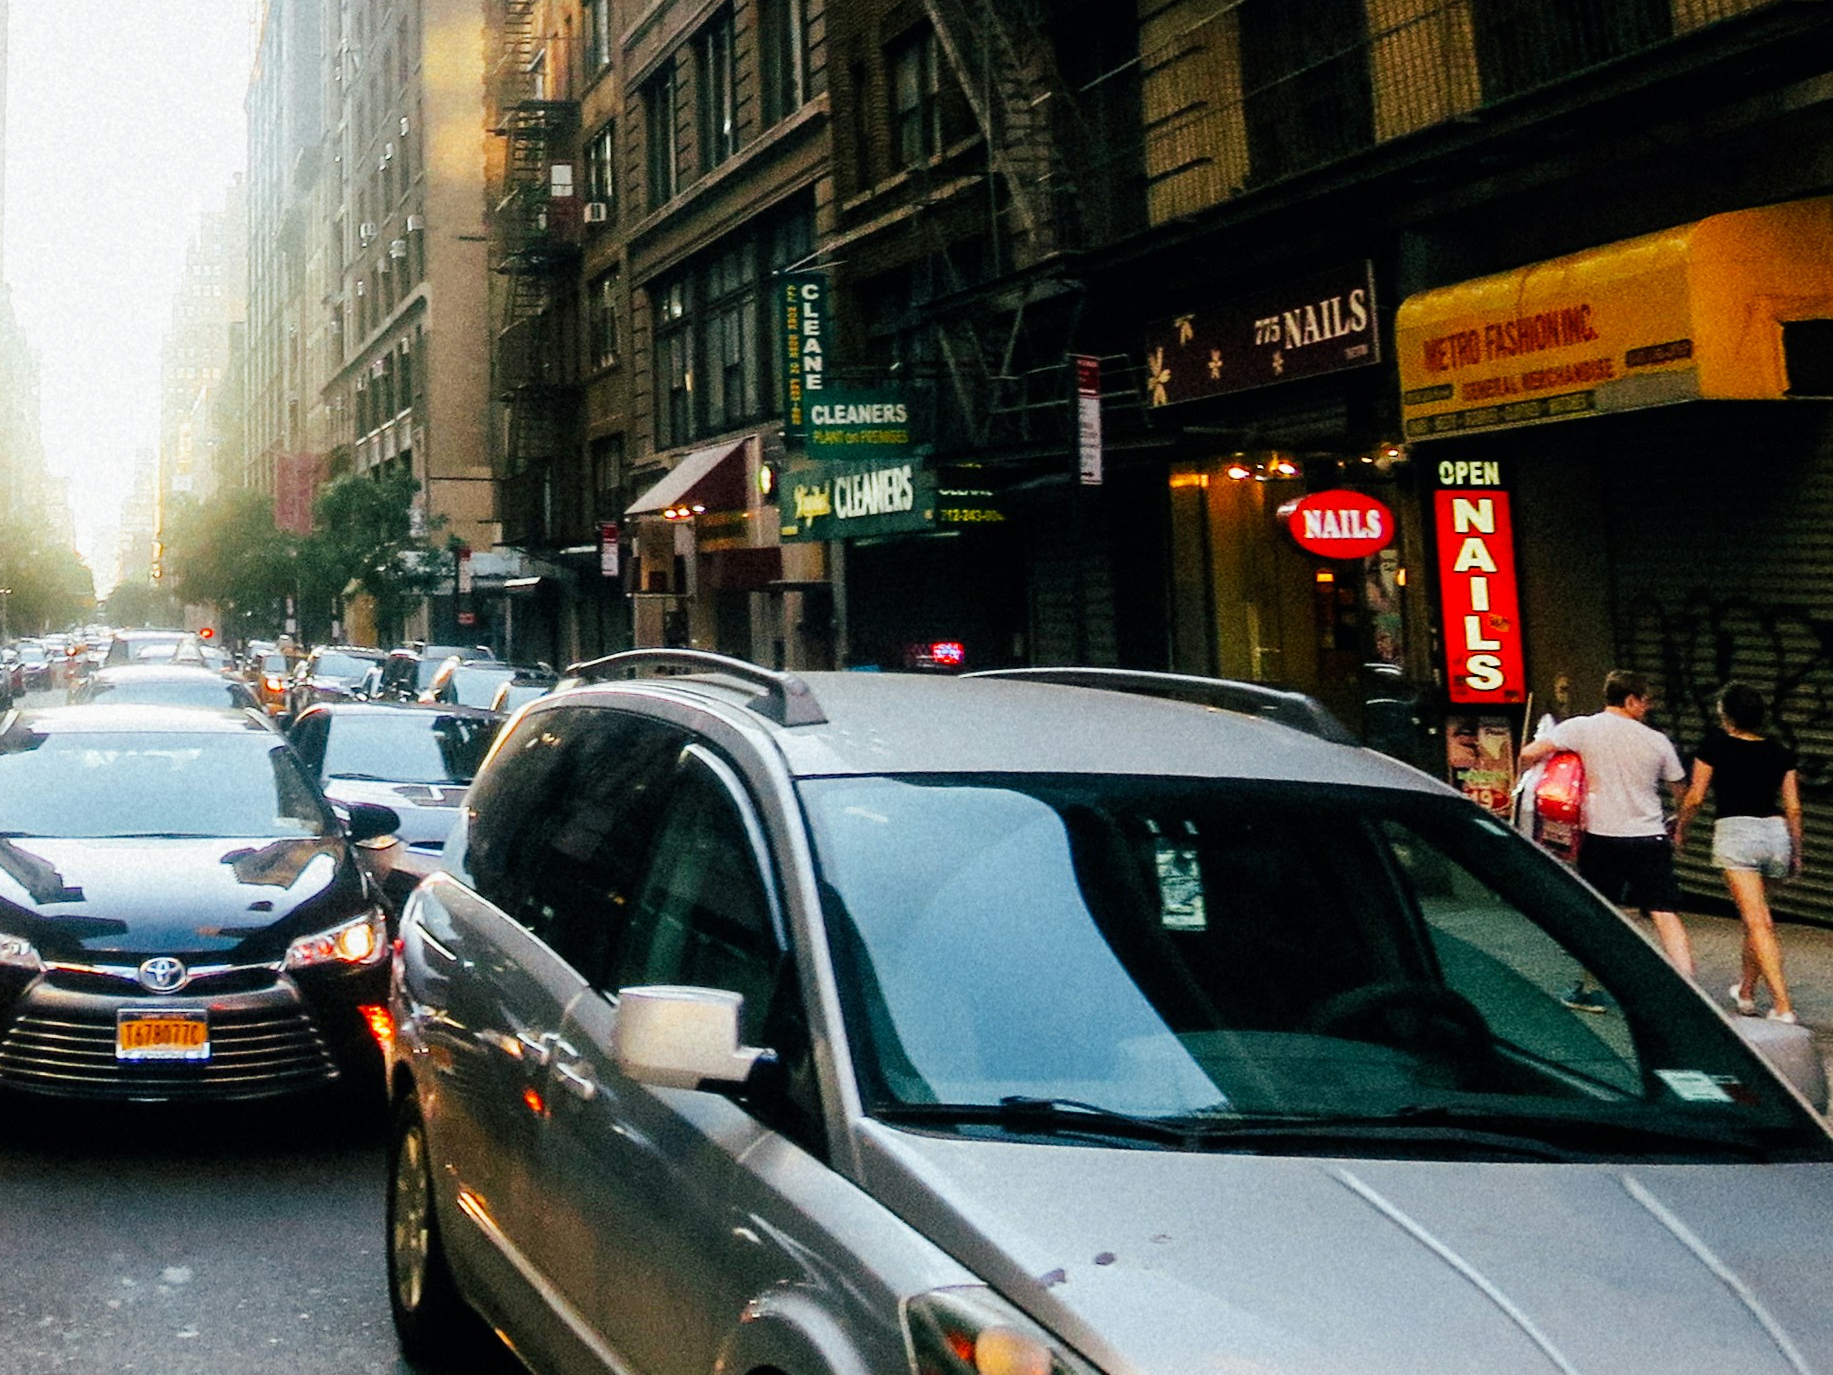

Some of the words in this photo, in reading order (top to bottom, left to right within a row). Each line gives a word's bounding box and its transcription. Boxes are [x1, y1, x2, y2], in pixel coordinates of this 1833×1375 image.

[801, 284, 823, 390] CLEANE
[1283, 288, 1368, 350] NAILS
[1423, 329, 1481, 373] METRO
[1483, 312, 1562, 361] FASHION
[811, 403, 908, 426] CLEANERS
[834, 464, 914, 520] CLEANERS
[1438, 459, 1501, 486] OPEN
[1302, 508, 1383, 539] NAILS
[1452, 497, 1506, 692] NAILS
